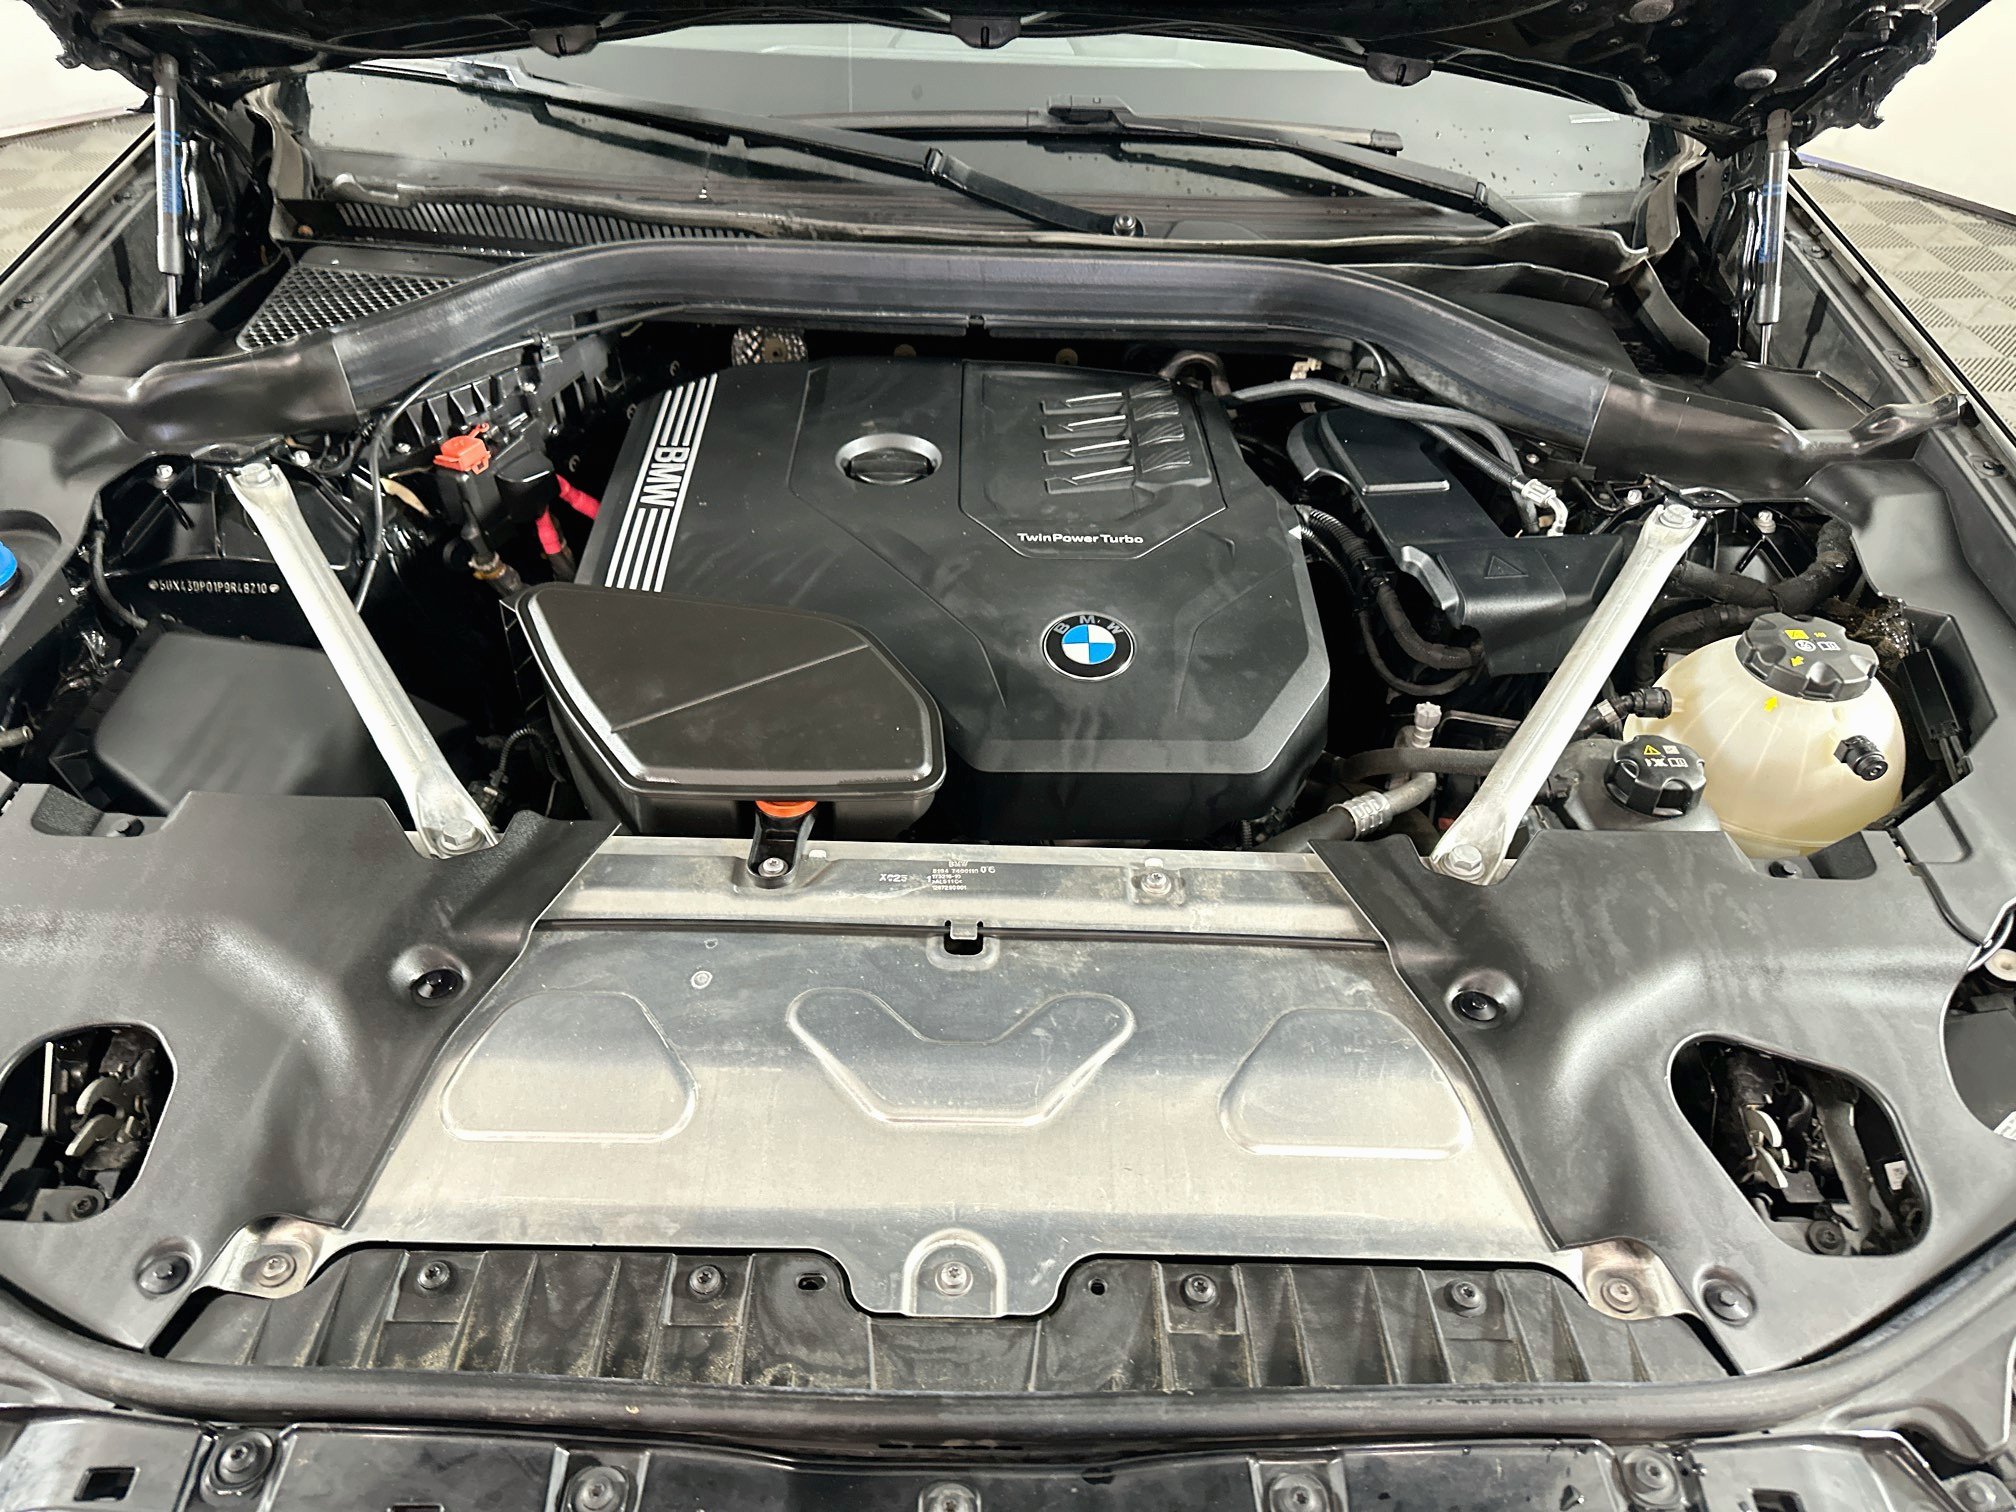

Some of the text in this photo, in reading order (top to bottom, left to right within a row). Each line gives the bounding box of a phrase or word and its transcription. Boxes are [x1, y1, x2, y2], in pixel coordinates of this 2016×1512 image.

[639, 446, 691, 508] BMW
[1099, 534, 1144, 544] Turbo
[1053, 615, 1124, 635] BMW
